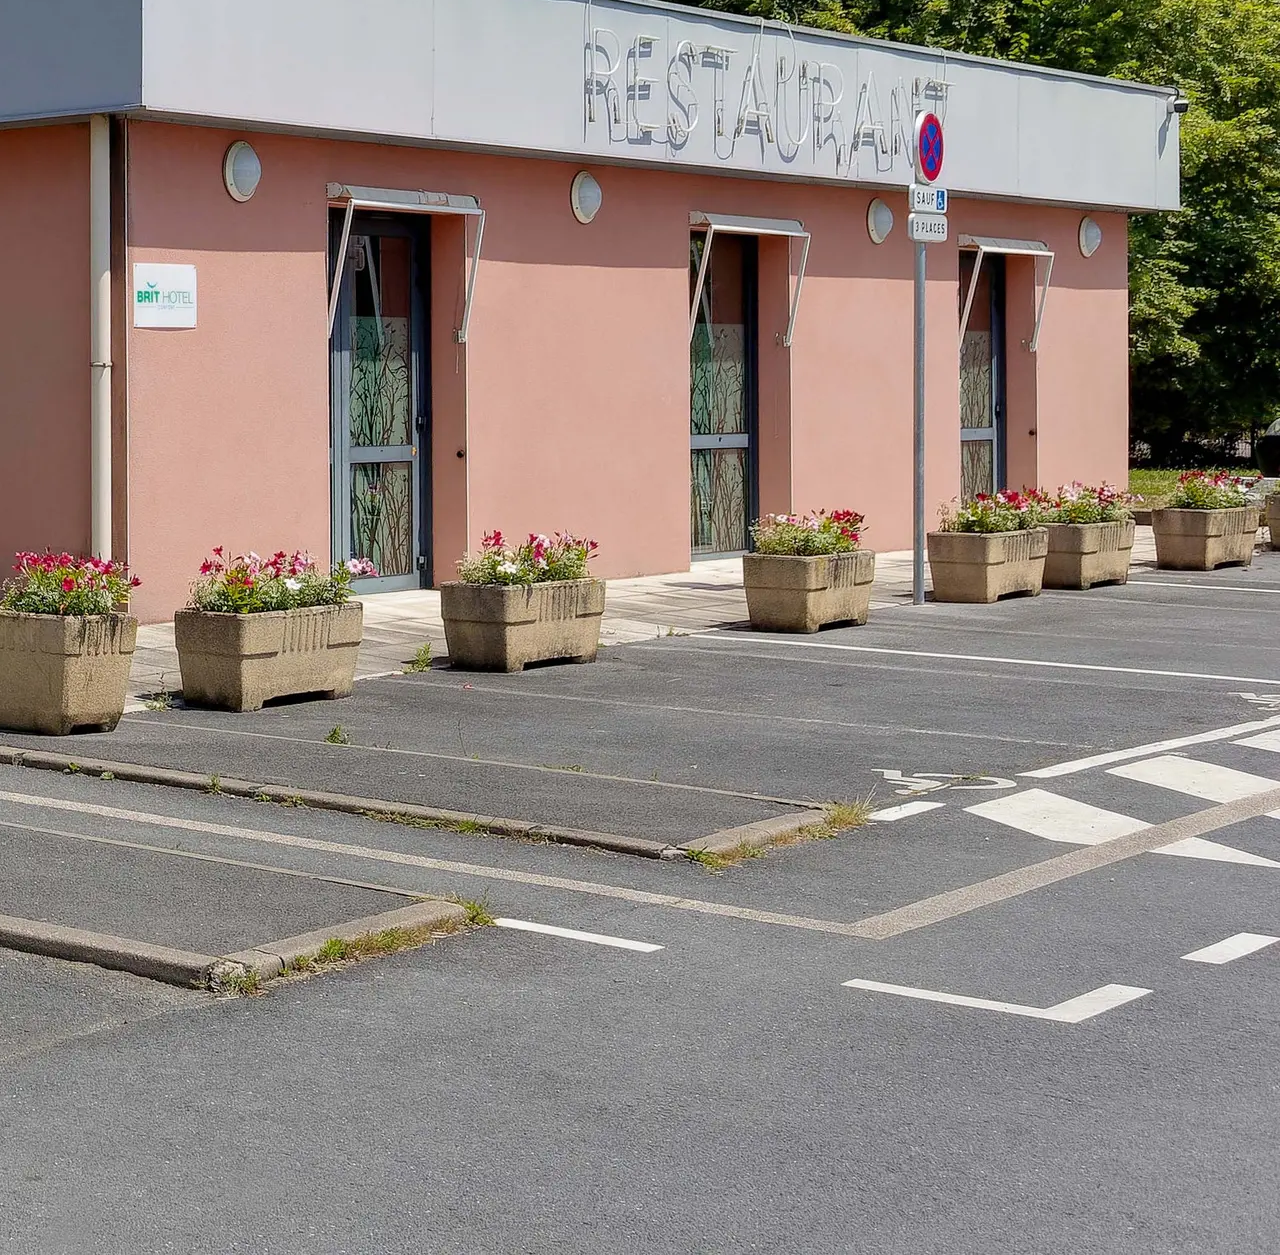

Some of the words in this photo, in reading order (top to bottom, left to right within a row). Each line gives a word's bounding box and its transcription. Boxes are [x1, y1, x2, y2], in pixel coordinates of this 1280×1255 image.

[587, 28, 956, 172] RESTAURANT
[916, 191, 935, 205] SAUF
[915, 221, 920, 233] 3
[921, 222, 946, 234] PLACES
[137, 291, 160, 303] BRIT
[162, 291, 194, 304] HOTEL
